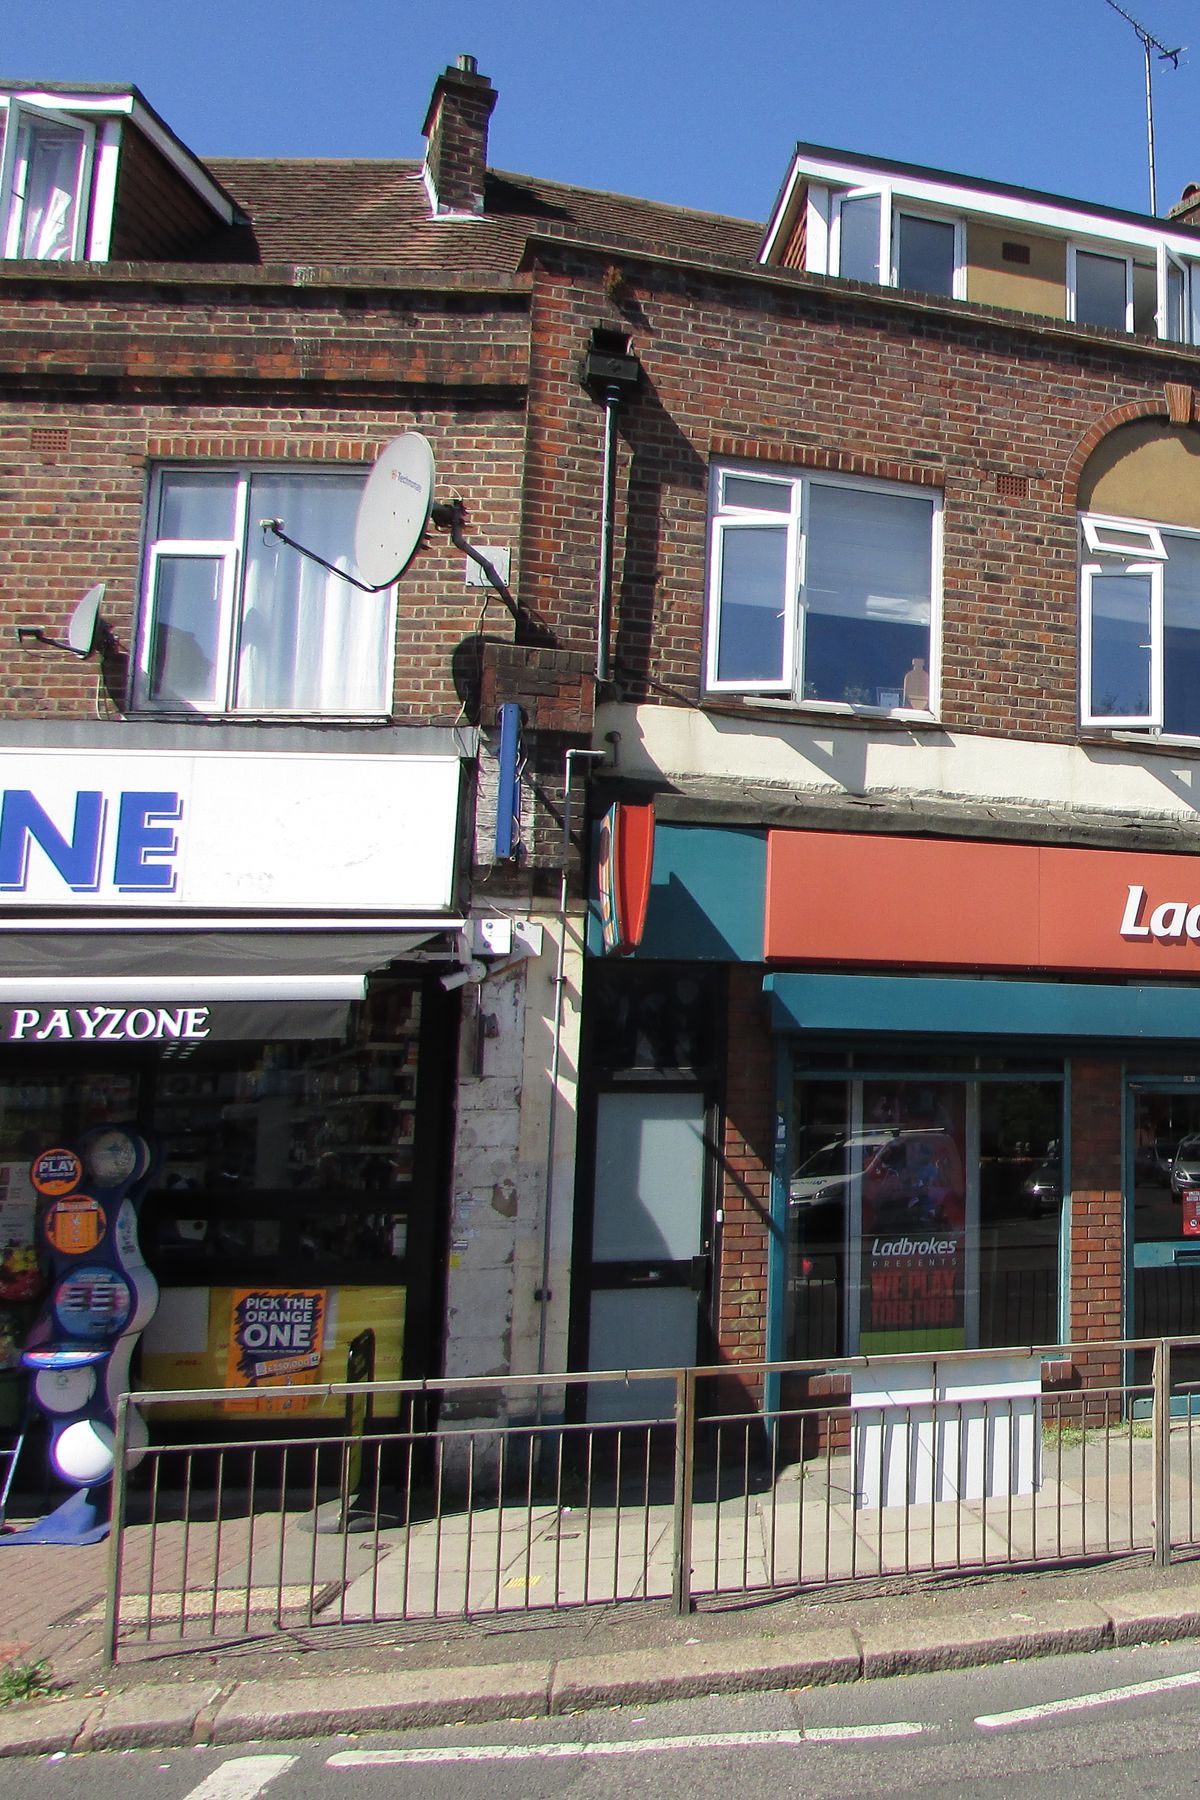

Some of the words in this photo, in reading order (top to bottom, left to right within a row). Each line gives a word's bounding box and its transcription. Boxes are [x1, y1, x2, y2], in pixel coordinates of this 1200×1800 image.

[10, 1006, 211, 1040] PAYZONE
[39, 1160, 77, 1173] PLAY
[871, 1237, 957, 1256] Ladbrokes
[872, 1258, 957, 1268] PRESENTS
[245, 1298, 281, 1310] PICK
[285, 1297, 314, 1310] THE
[245, 1310, 312, 1323] ORANGE
[243, 1323, 312, 1347] ONE
